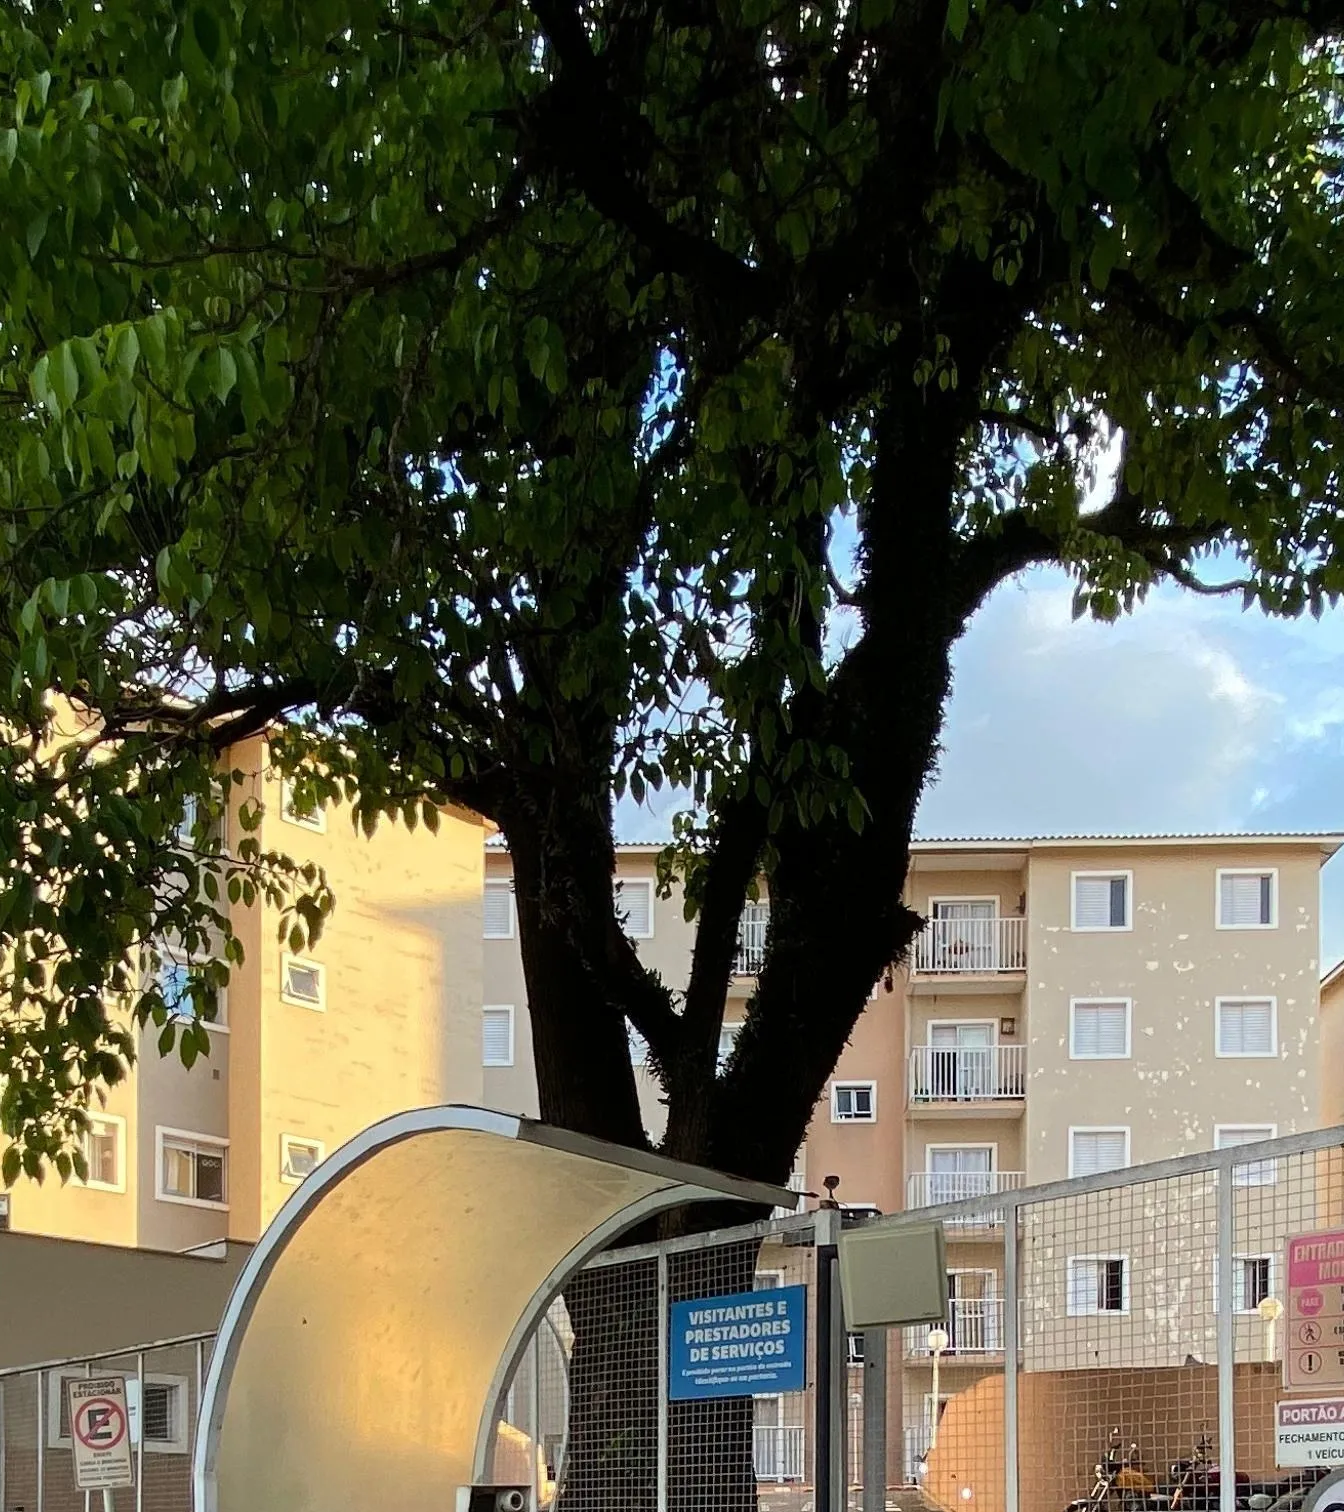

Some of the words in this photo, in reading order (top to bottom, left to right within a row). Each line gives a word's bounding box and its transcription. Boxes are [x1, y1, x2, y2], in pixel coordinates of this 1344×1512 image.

[688, 1301, 774, 1325] VISITANTES
[777, 1300, 787, 1315] E
[685, 1320, 791, 1344] PRESTADORES
[690, 1347, 709, 1362] DE
[711, 1340, 785, 1361] SERVIÇOS
[88, 1408, 113, 1440] E
[1282, 1406, 1338, 1423] PORTÃO
